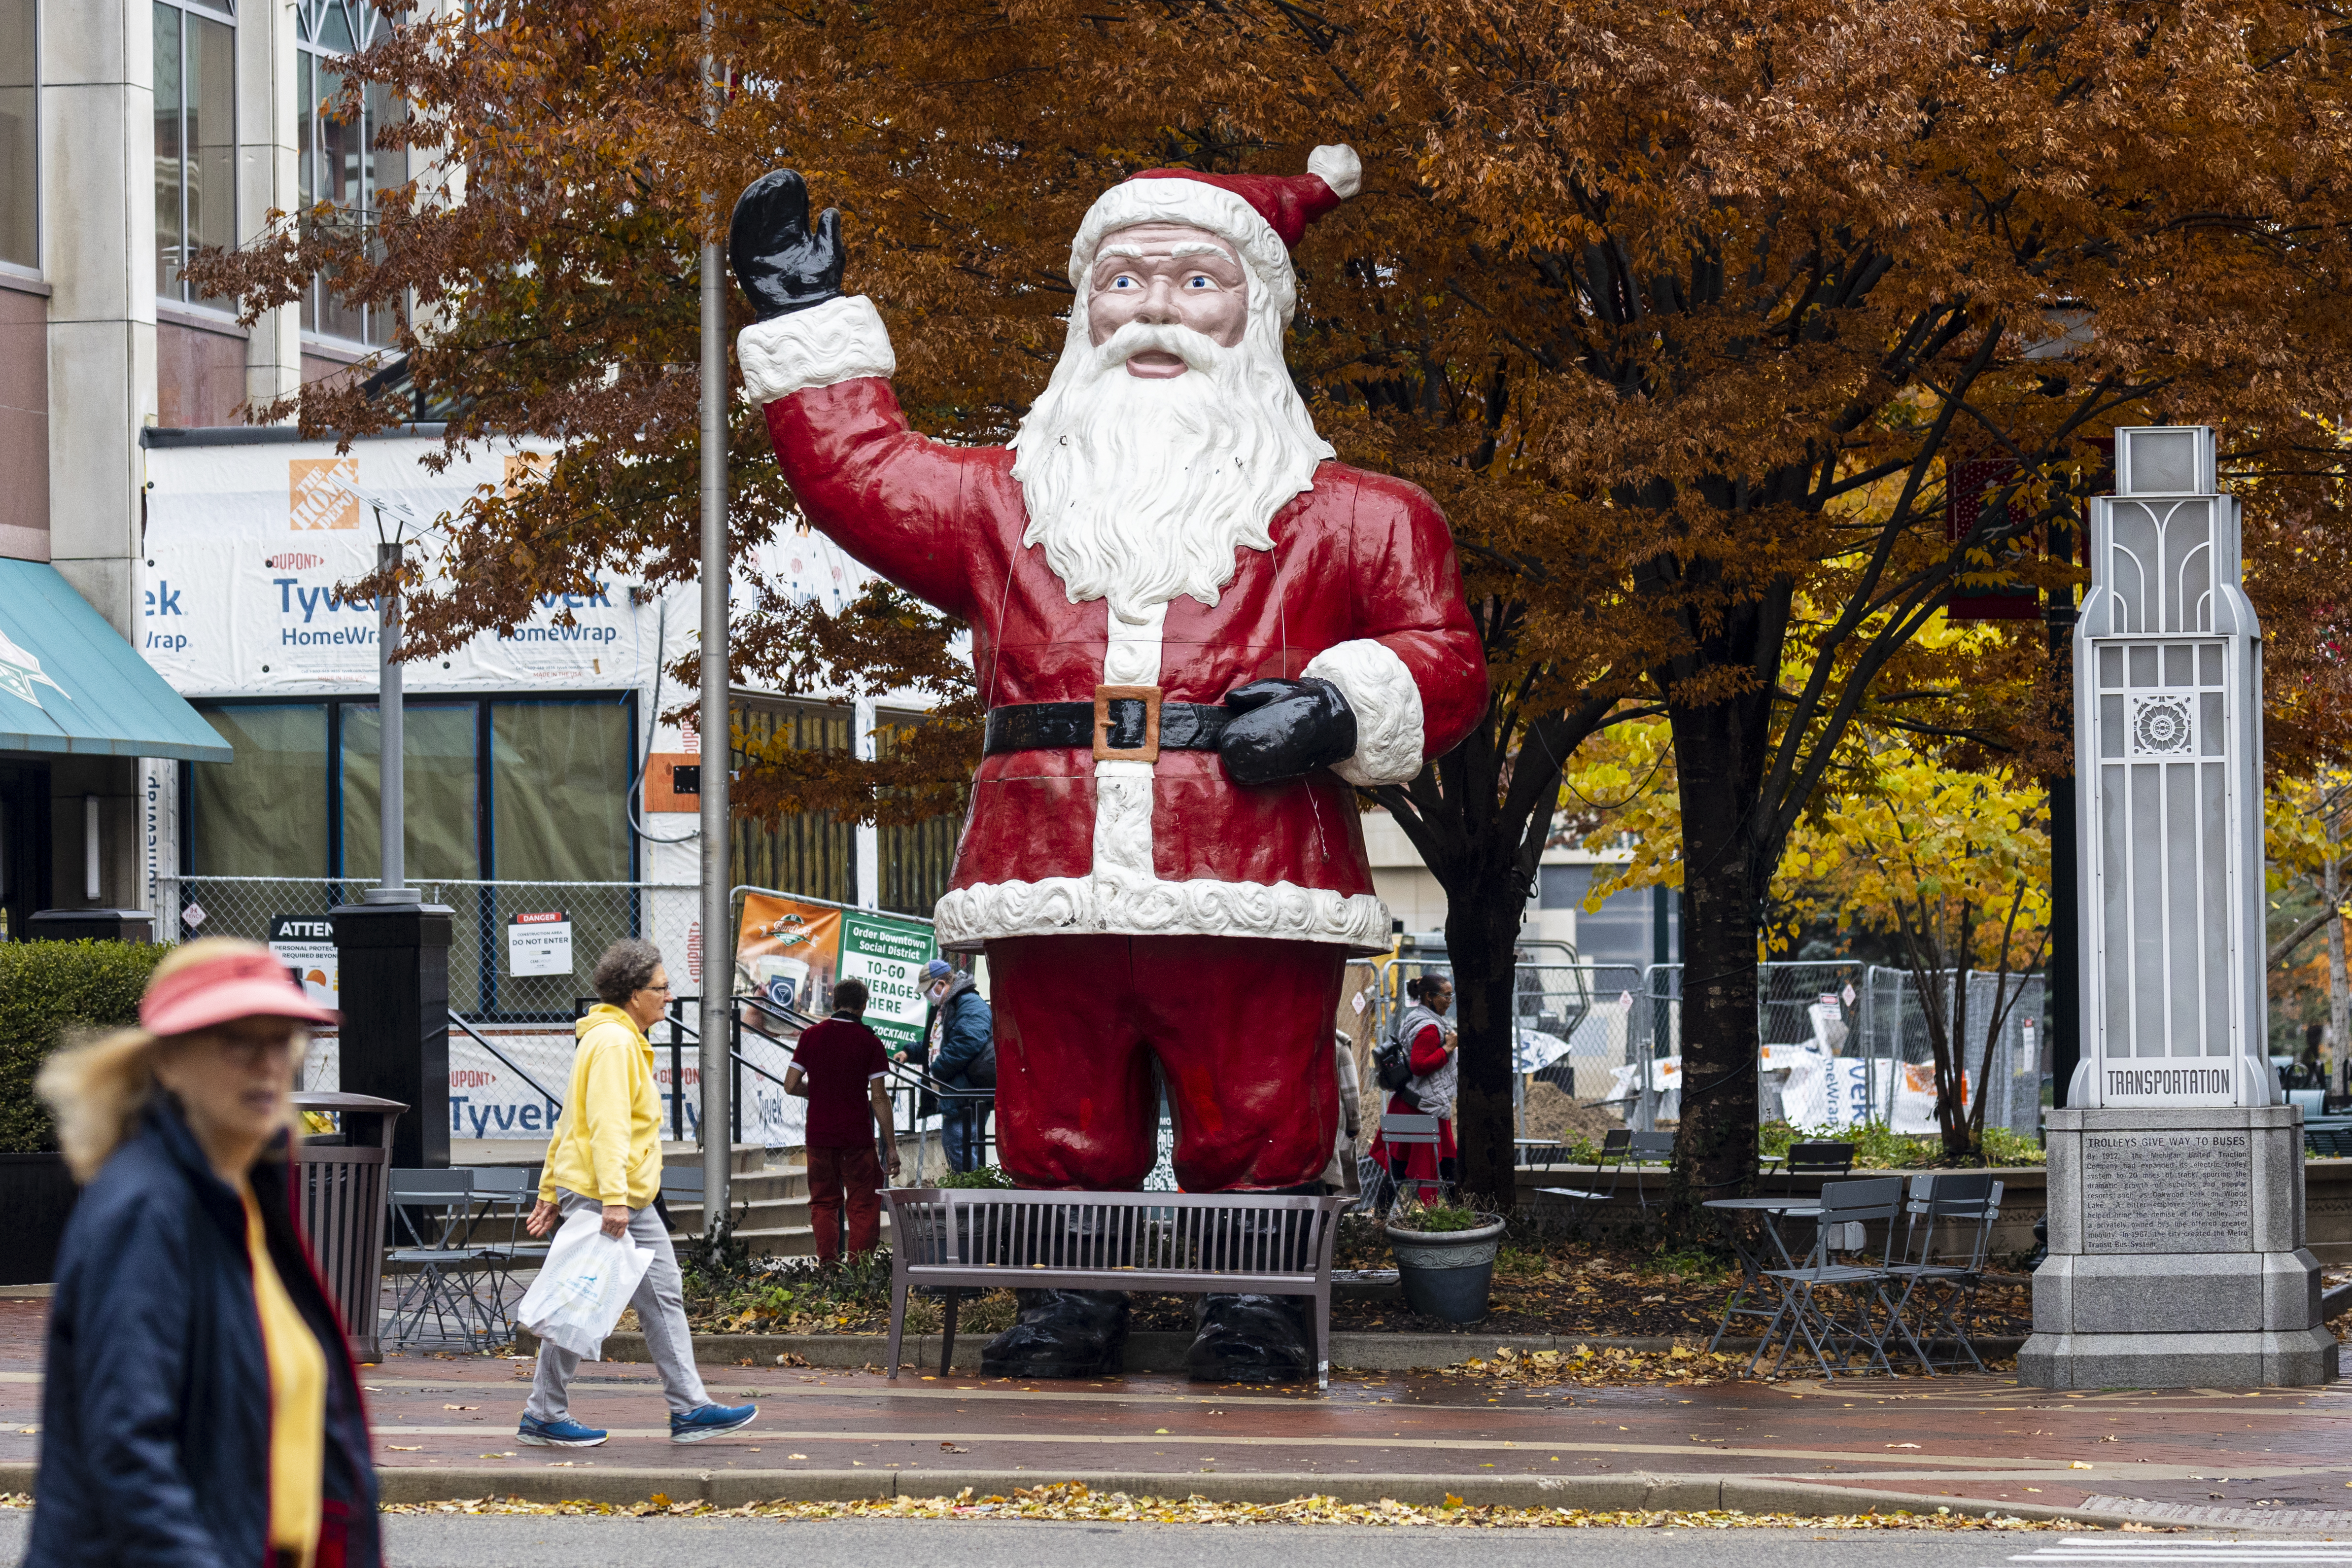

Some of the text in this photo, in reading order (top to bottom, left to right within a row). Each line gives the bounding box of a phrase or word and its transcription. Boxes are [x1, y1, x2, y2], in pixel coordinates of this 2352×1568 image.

[296, 466, 325, 494] THE
[290, 458, 358, 529] HOME
[317, 491, 358, 529] DEPO
[272, 553, 317, 570] DUPONT
[282, 627, 380, 645] HomeWr
[853, 927, 926, 949] Order Downtown
[859, 940, 920, 961] Social District
[867, 961, 905, 979] TO-GO
[868, 996, 901, 1014] HERE
[2108, 1069, 2229, 1095] TRANSPORTATION
[2088, 1137, 2245, 1147] TROLLEYS GIVE WAY TO BUSES
